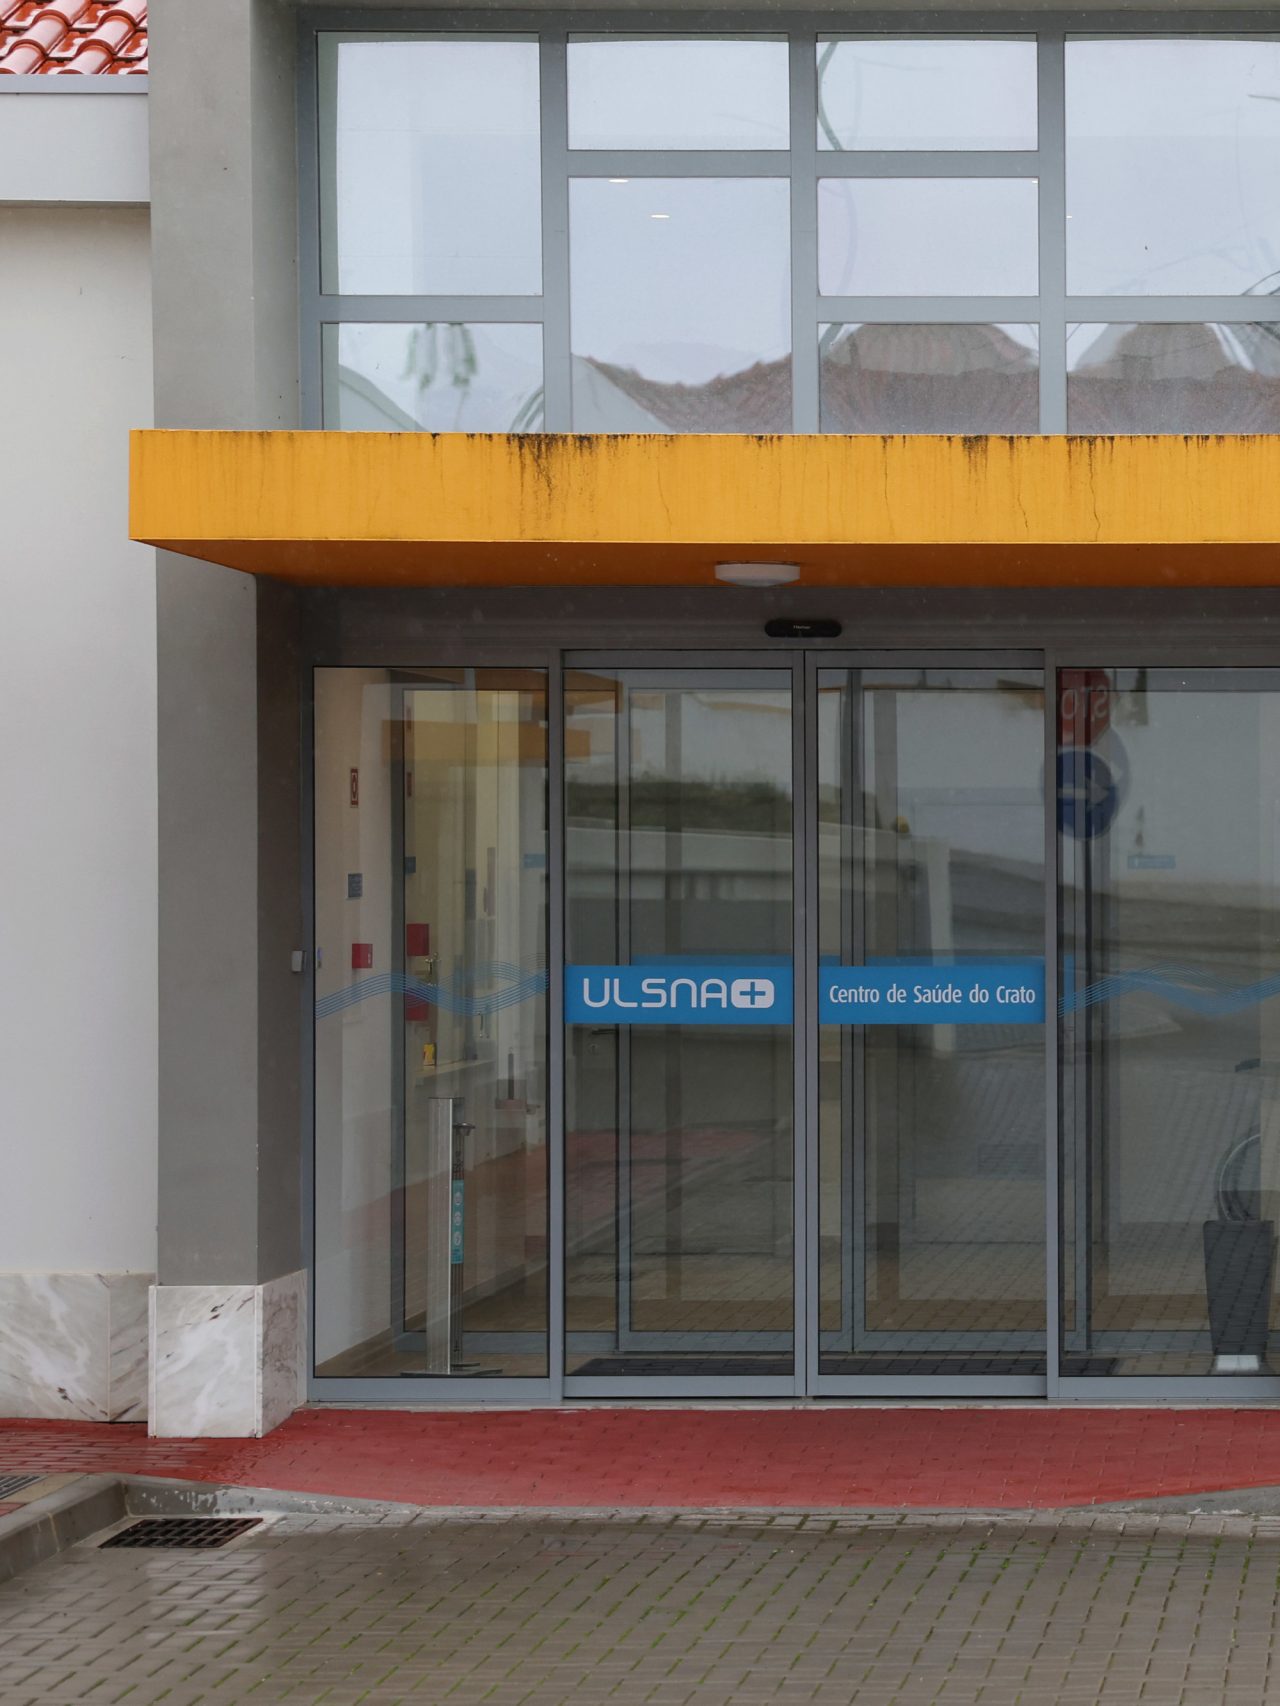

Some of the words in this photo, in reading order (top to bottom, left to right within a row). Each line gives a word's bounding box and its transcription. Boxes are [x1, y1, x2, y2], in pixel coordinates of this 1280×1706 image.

[829, 984, 880, 1004] Centro
[886, 984, 907, 1004] de
[913, 983, 962, 1004] Saúde
[969, 984, 990, 1004] do
[996, 984, 1036, 1004] Crato
